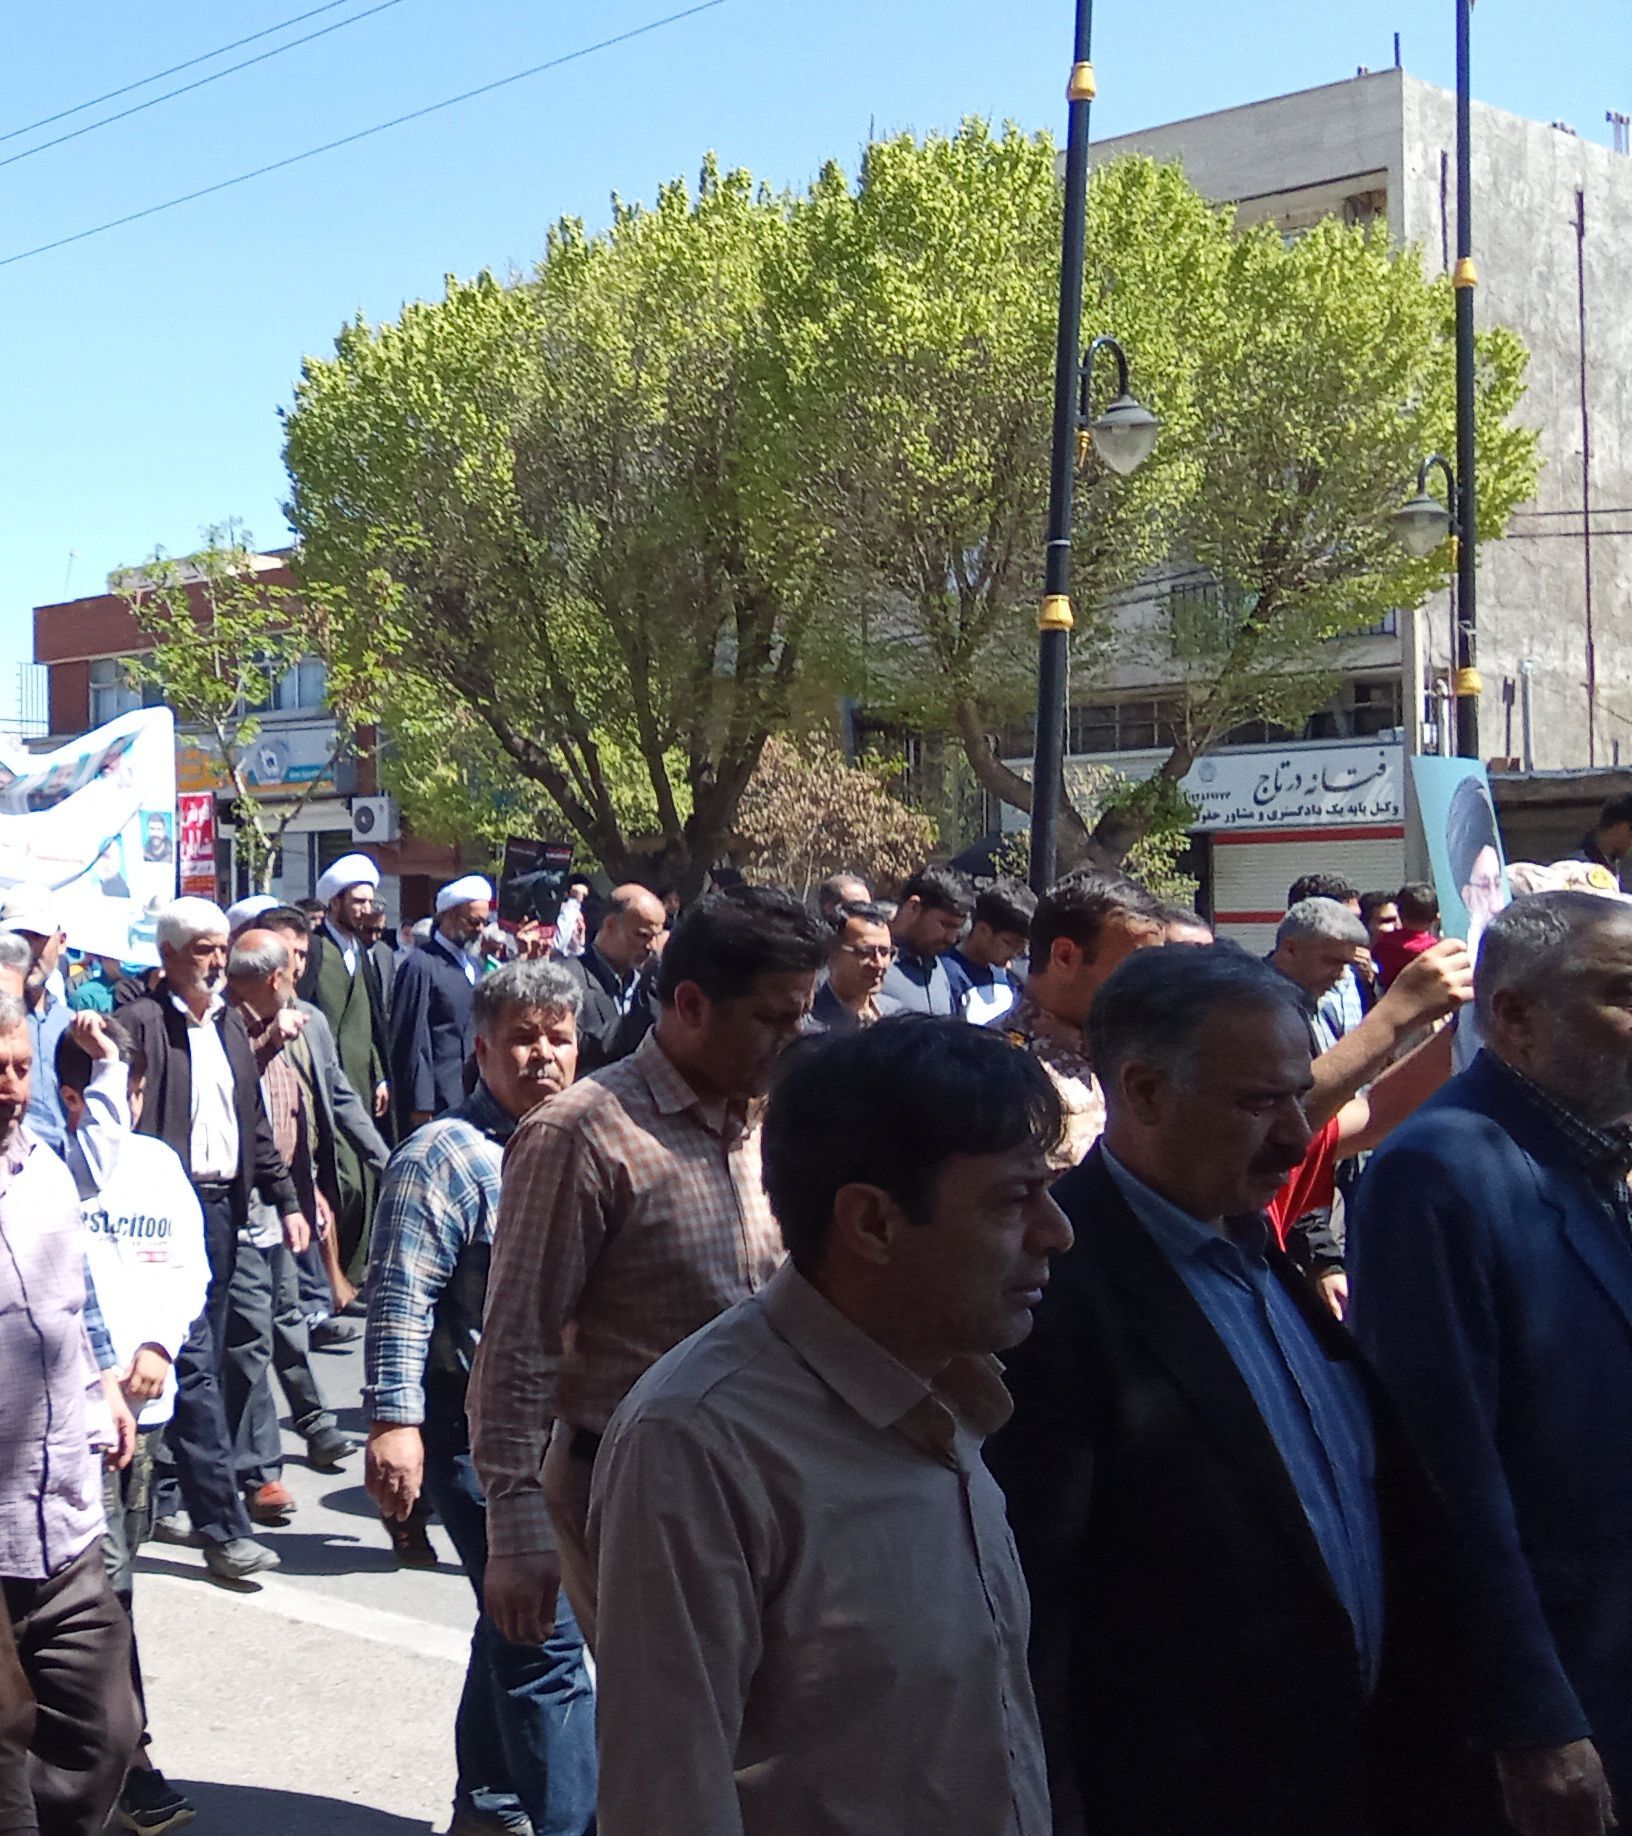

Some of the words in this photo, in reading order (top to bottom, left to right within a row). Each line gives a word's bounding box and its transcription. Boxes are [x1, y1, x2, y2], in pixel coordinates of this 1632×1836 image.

[1225, 807, 1254, 823] مشاور
[1267, 804, 1322, 820] دادگستری
[1326, 803, 1344, 817] یک
[1348, 802, 1367, 817] پایه
[1370, 801, 1399, 816] وکیل
